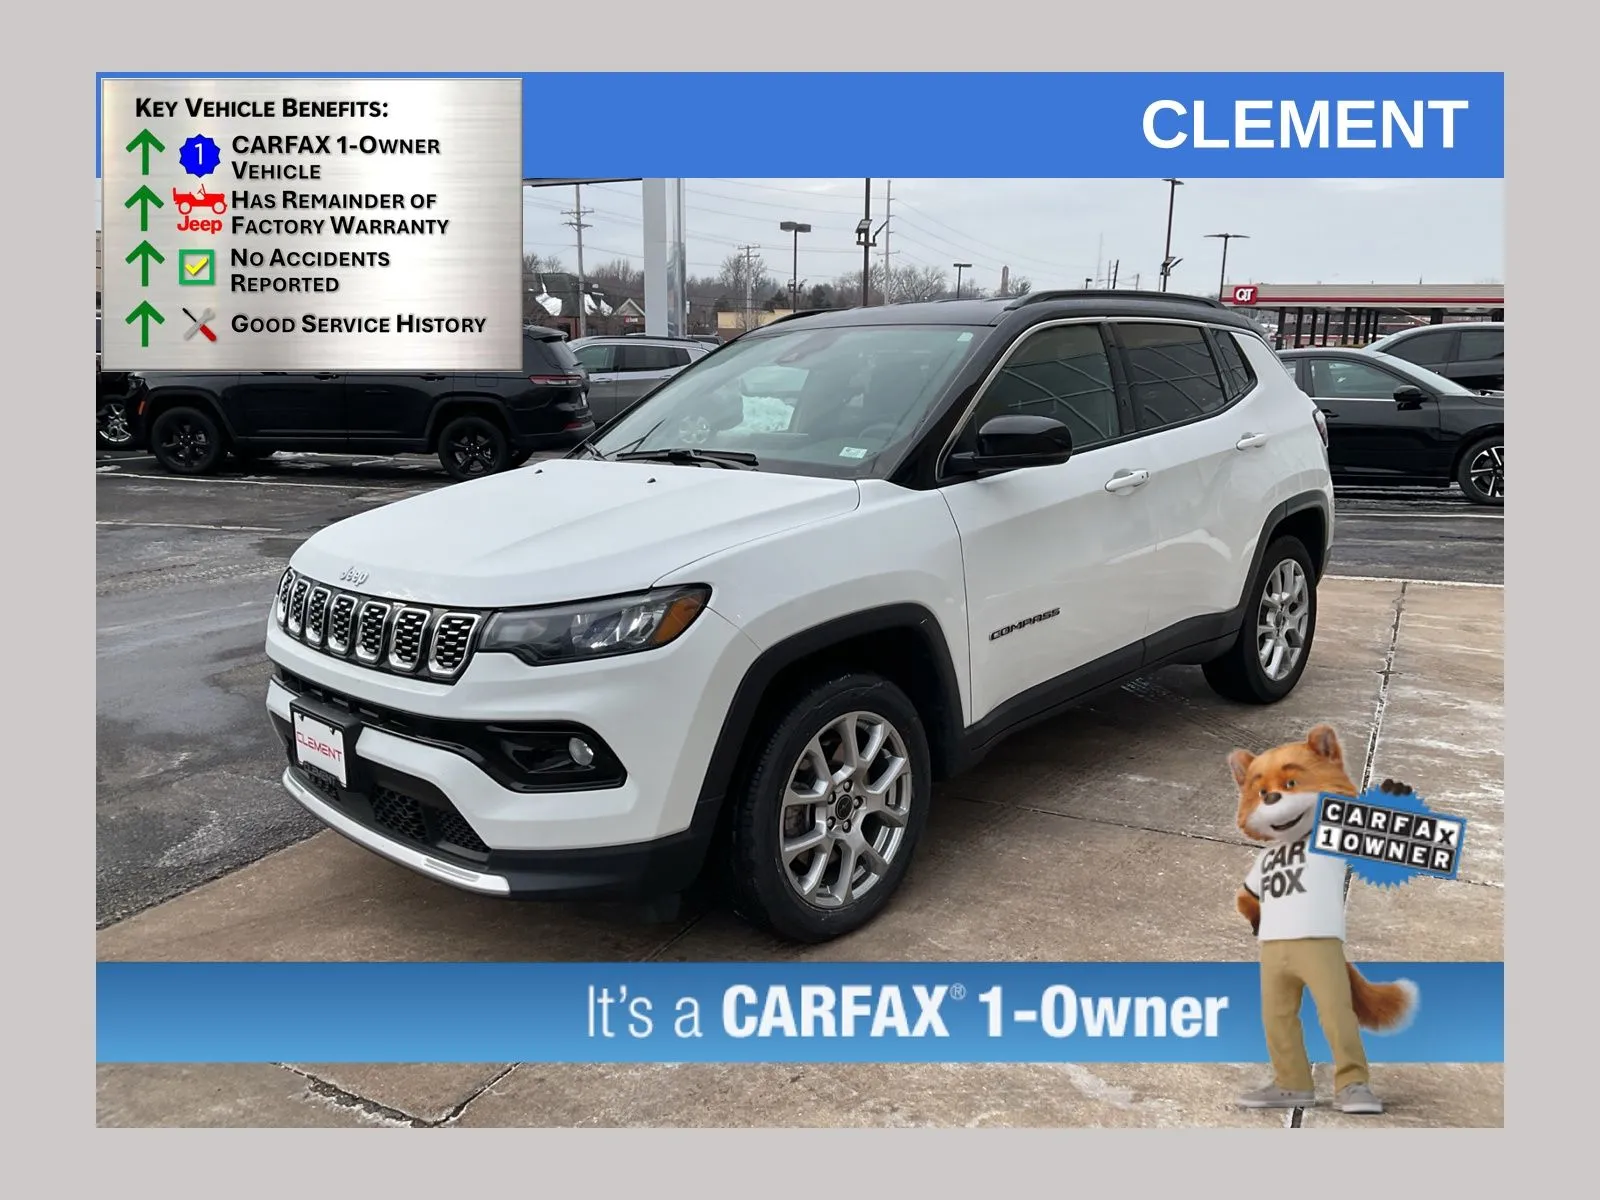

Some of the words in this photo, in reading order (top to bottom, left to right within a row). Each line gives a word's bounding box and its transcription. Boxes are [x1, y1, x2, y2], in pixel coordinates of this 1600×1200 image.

[1235, 288, 1254, 301] QT
[340, 566, 369, 588] Jeep
[988, 607, 1061, 641] COMPASS
[296, 730, 343, 761] CLEMENT
